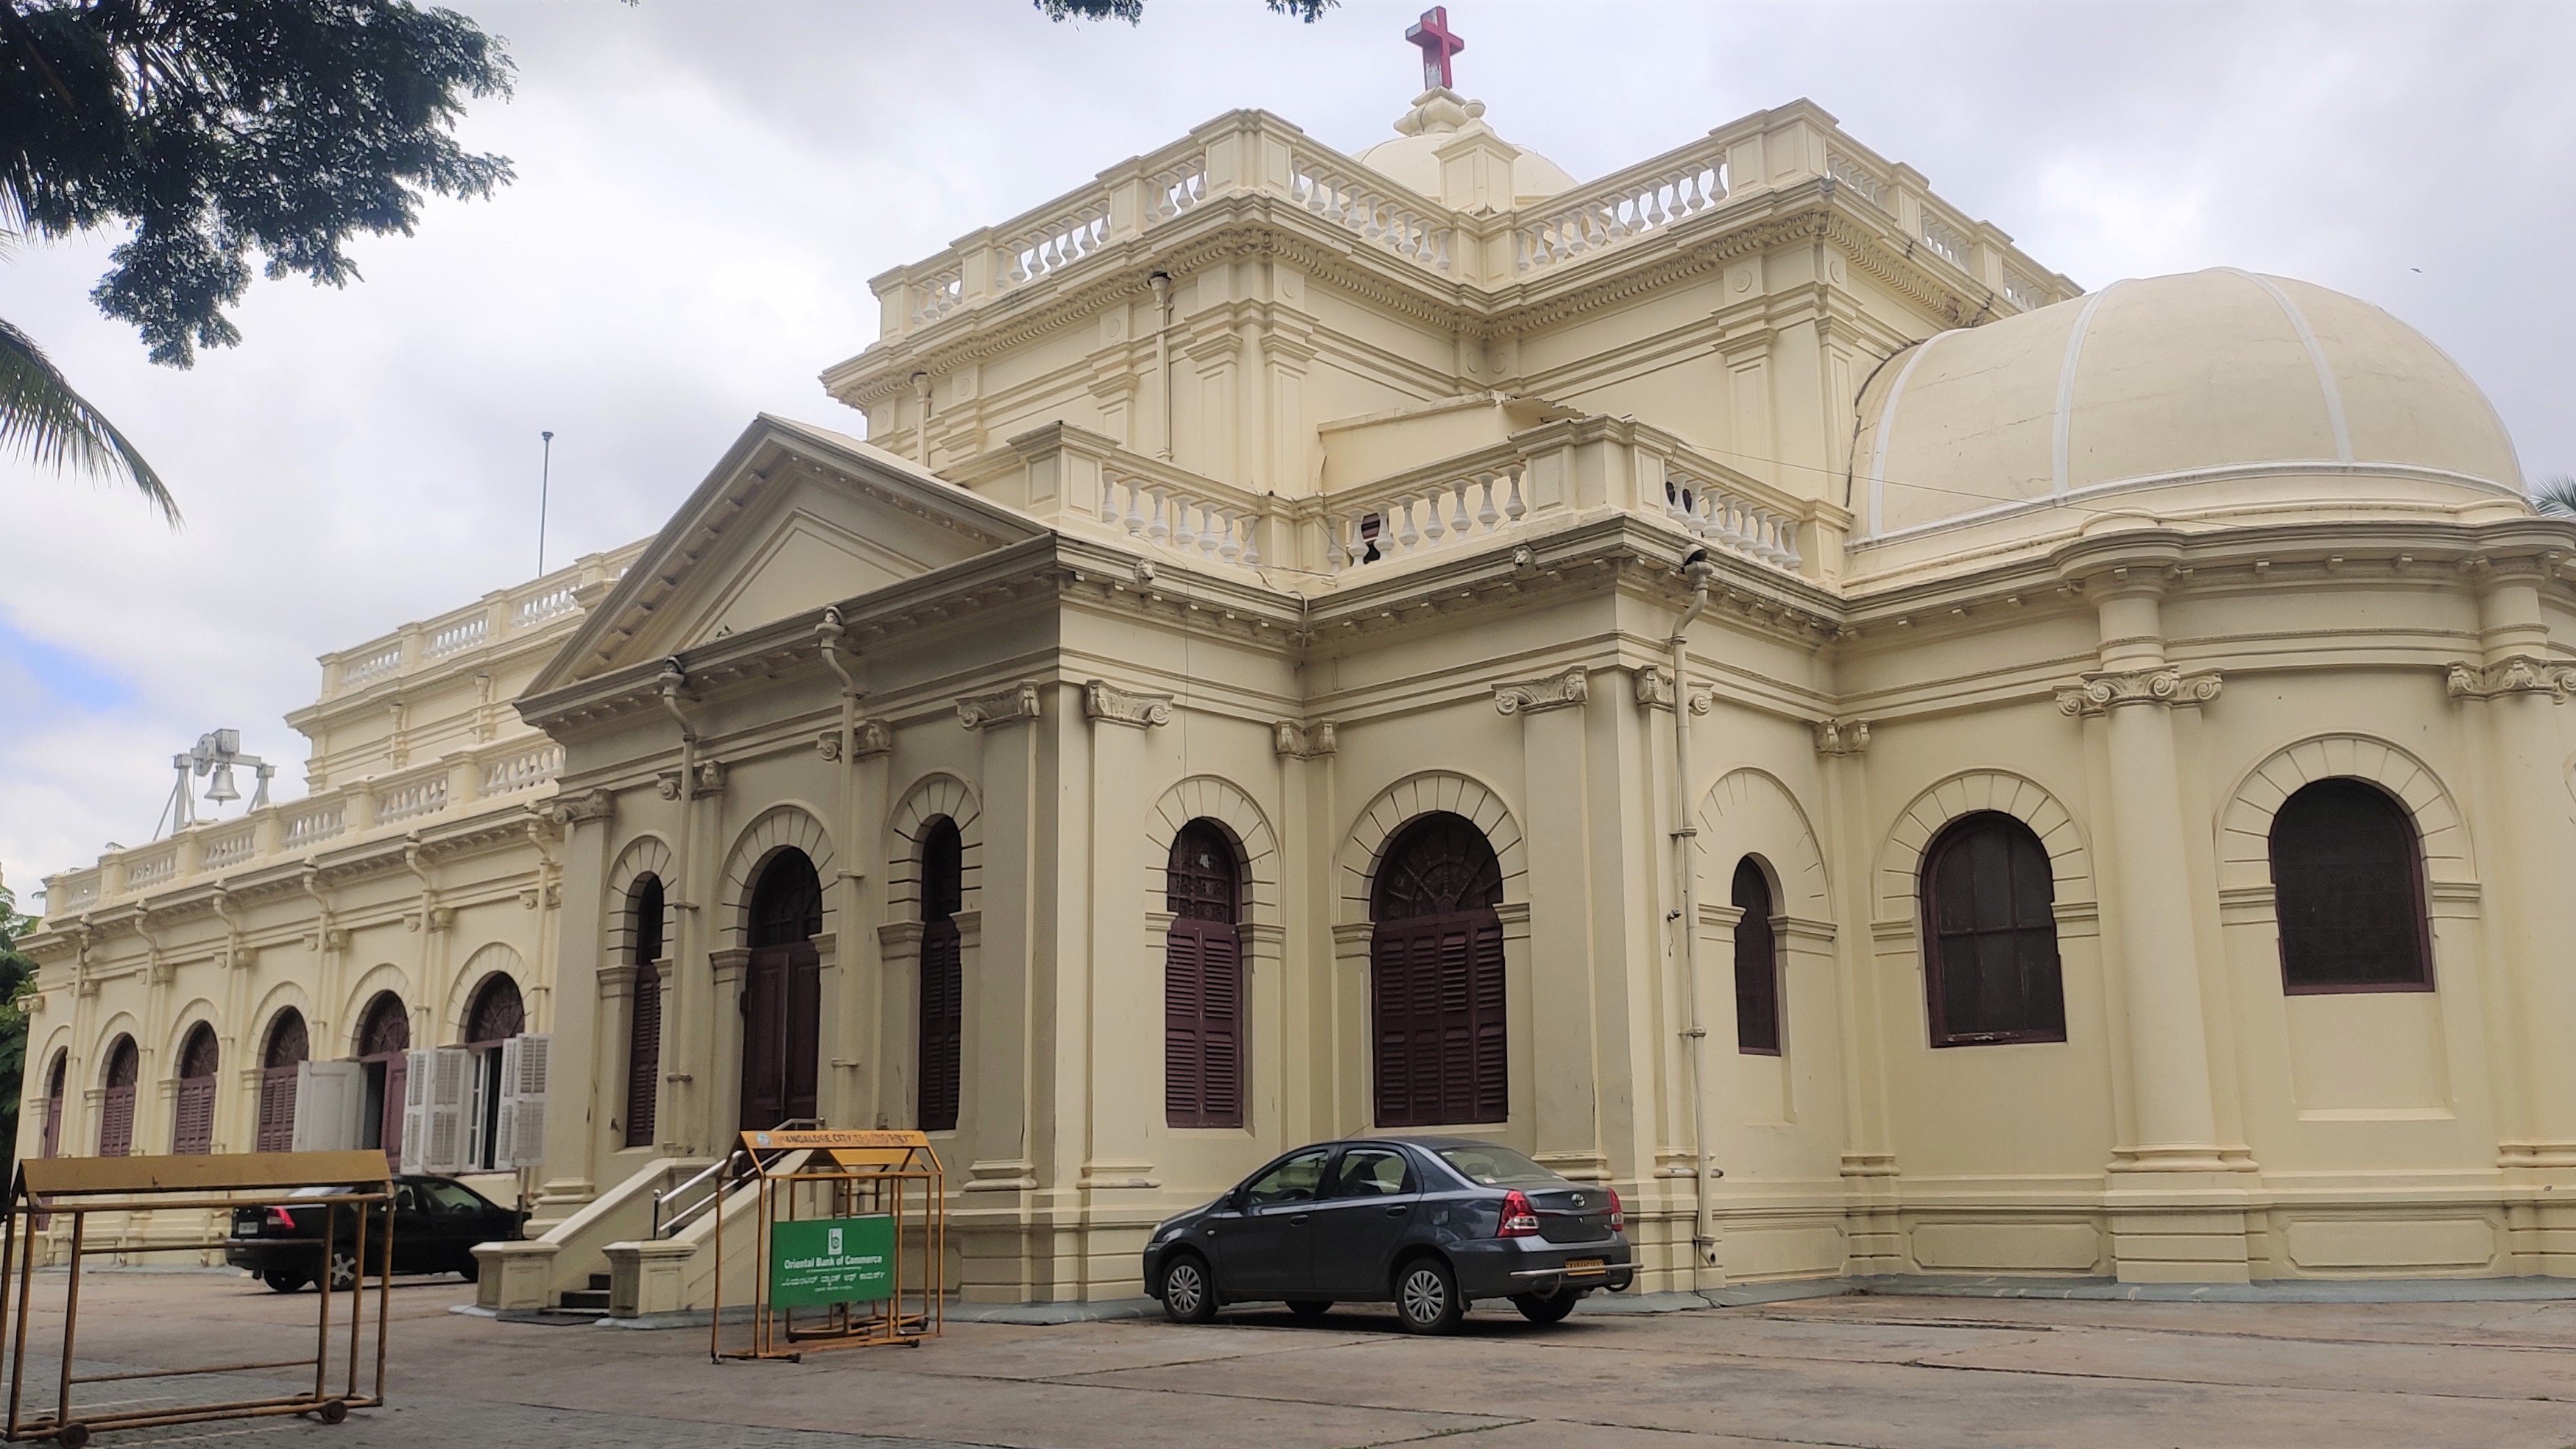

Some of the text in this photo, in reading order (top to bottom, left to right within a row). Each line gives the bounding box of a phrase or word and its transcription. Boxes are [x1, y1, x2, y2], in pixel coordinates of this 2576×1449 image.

[833, 1133, 852, 1143] CITY
[784, 1255, 883, 1269] Oriental Bank of Commerce
